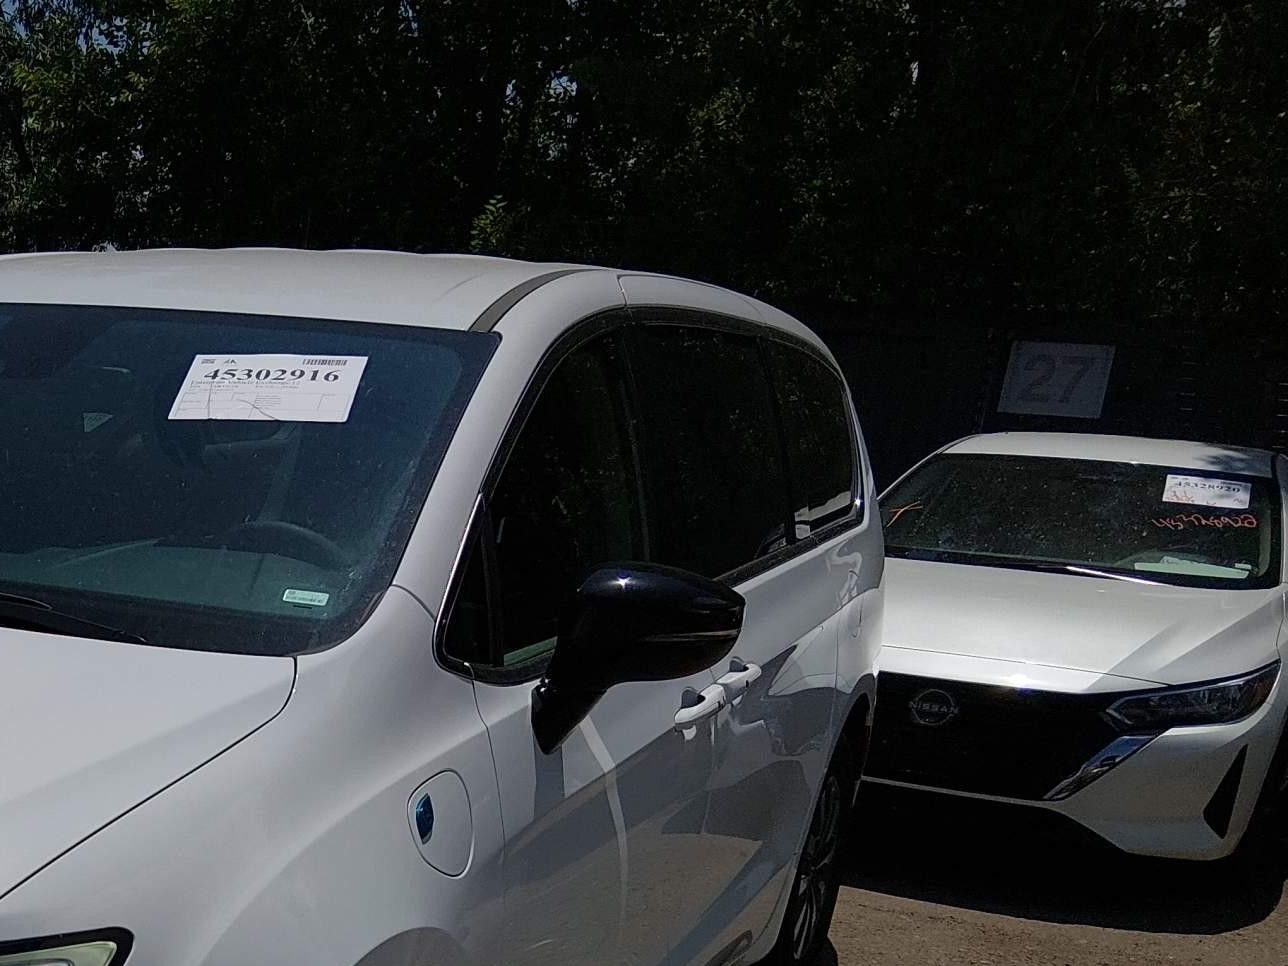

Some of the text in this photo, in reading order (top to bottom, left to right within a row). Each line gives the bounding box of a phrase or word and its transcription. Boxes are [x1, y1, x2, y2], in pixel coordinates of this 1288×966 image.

[203, 368, 342, 382] 45302916
[1019, 354, 1096, 404] 27
[909, 701, 959, 714] NISSAN
